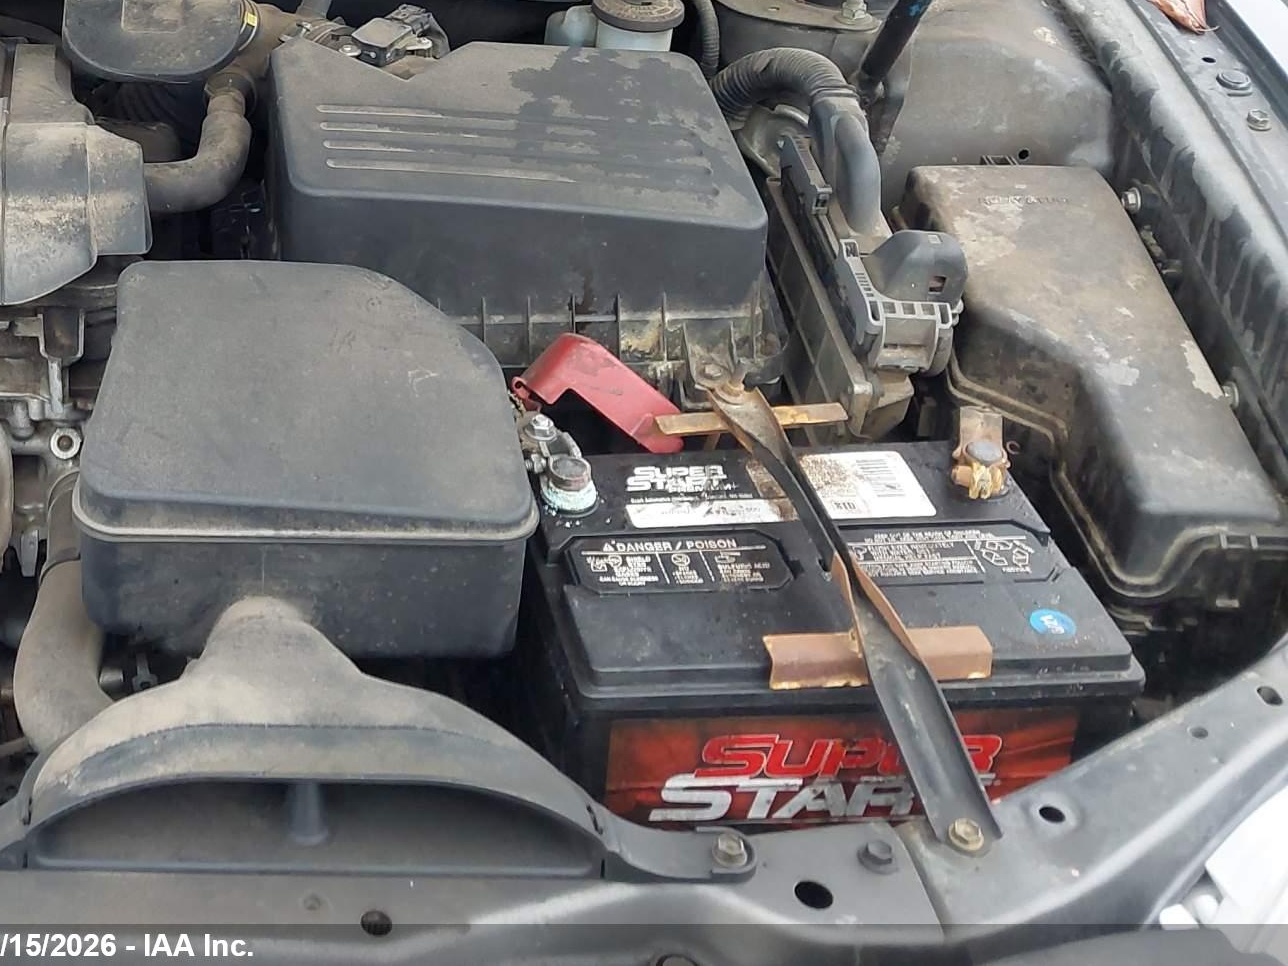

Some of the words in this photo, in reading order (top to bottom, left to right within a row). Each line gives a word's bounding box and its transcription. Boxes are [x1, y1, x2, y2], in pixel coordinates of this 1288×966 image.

[633, 465, 725, 479] SUPER
[616, 542, 673, 551] DANGER
[686, 538, 738, 549] POISON
